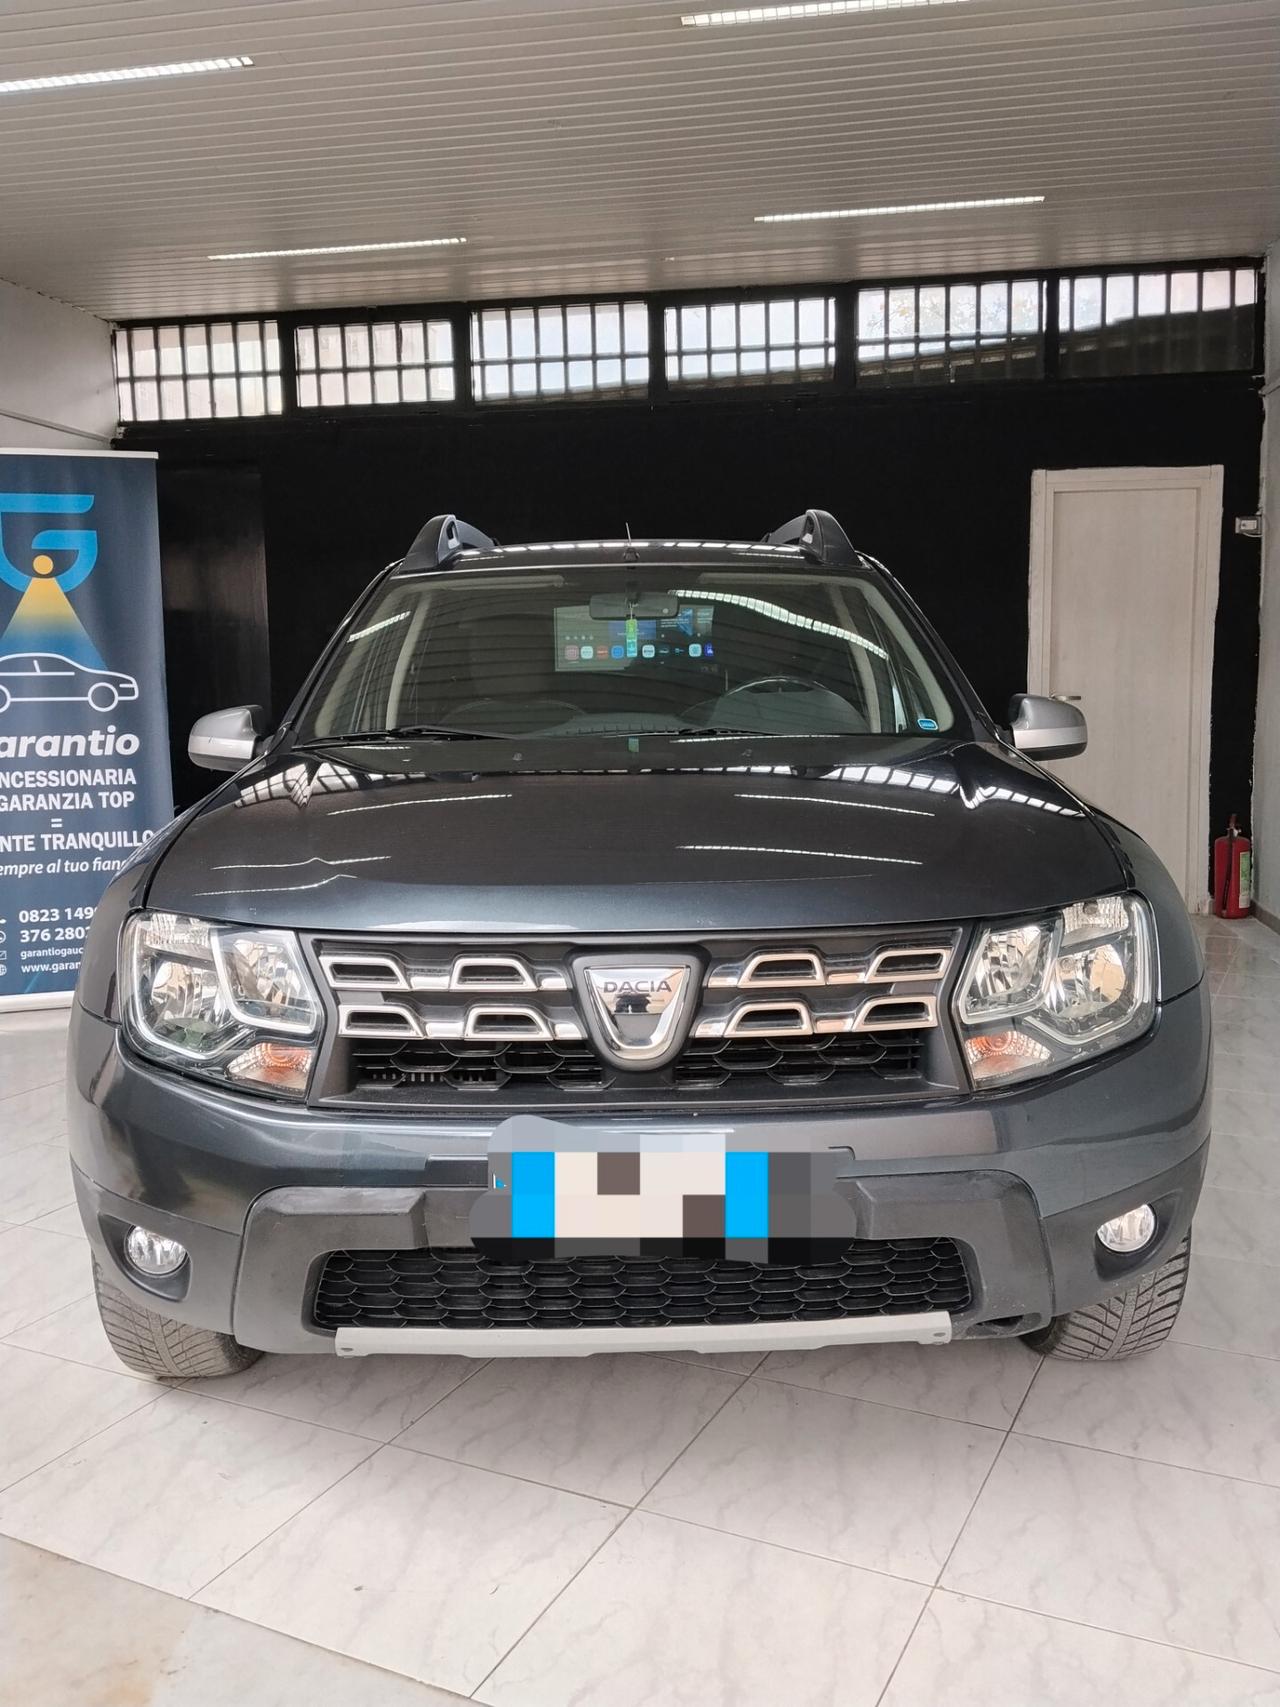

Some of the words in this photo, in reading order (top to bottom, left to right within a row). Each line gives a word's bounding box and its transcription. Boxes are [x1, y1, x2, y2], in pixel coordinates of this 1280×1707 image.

[0, 725, 140, 758] arantio
[0, 768, 137, 789] NCESSIONARIA
[0, 792, 94, 812] GARANZIA
[98, 791, 135, 809] TOP
[0, 834, 36, 853] NTE
[0, 863, 44, 878] empre
[46, 858, 61, 874] al
[64, 860, 89, 873] tuo
[19, 908, 60, 924] 0823
[64, 906, 98, 920] 149
[20, 928, 51, 943] 376
[603, 980, 672, 993] DACIA
